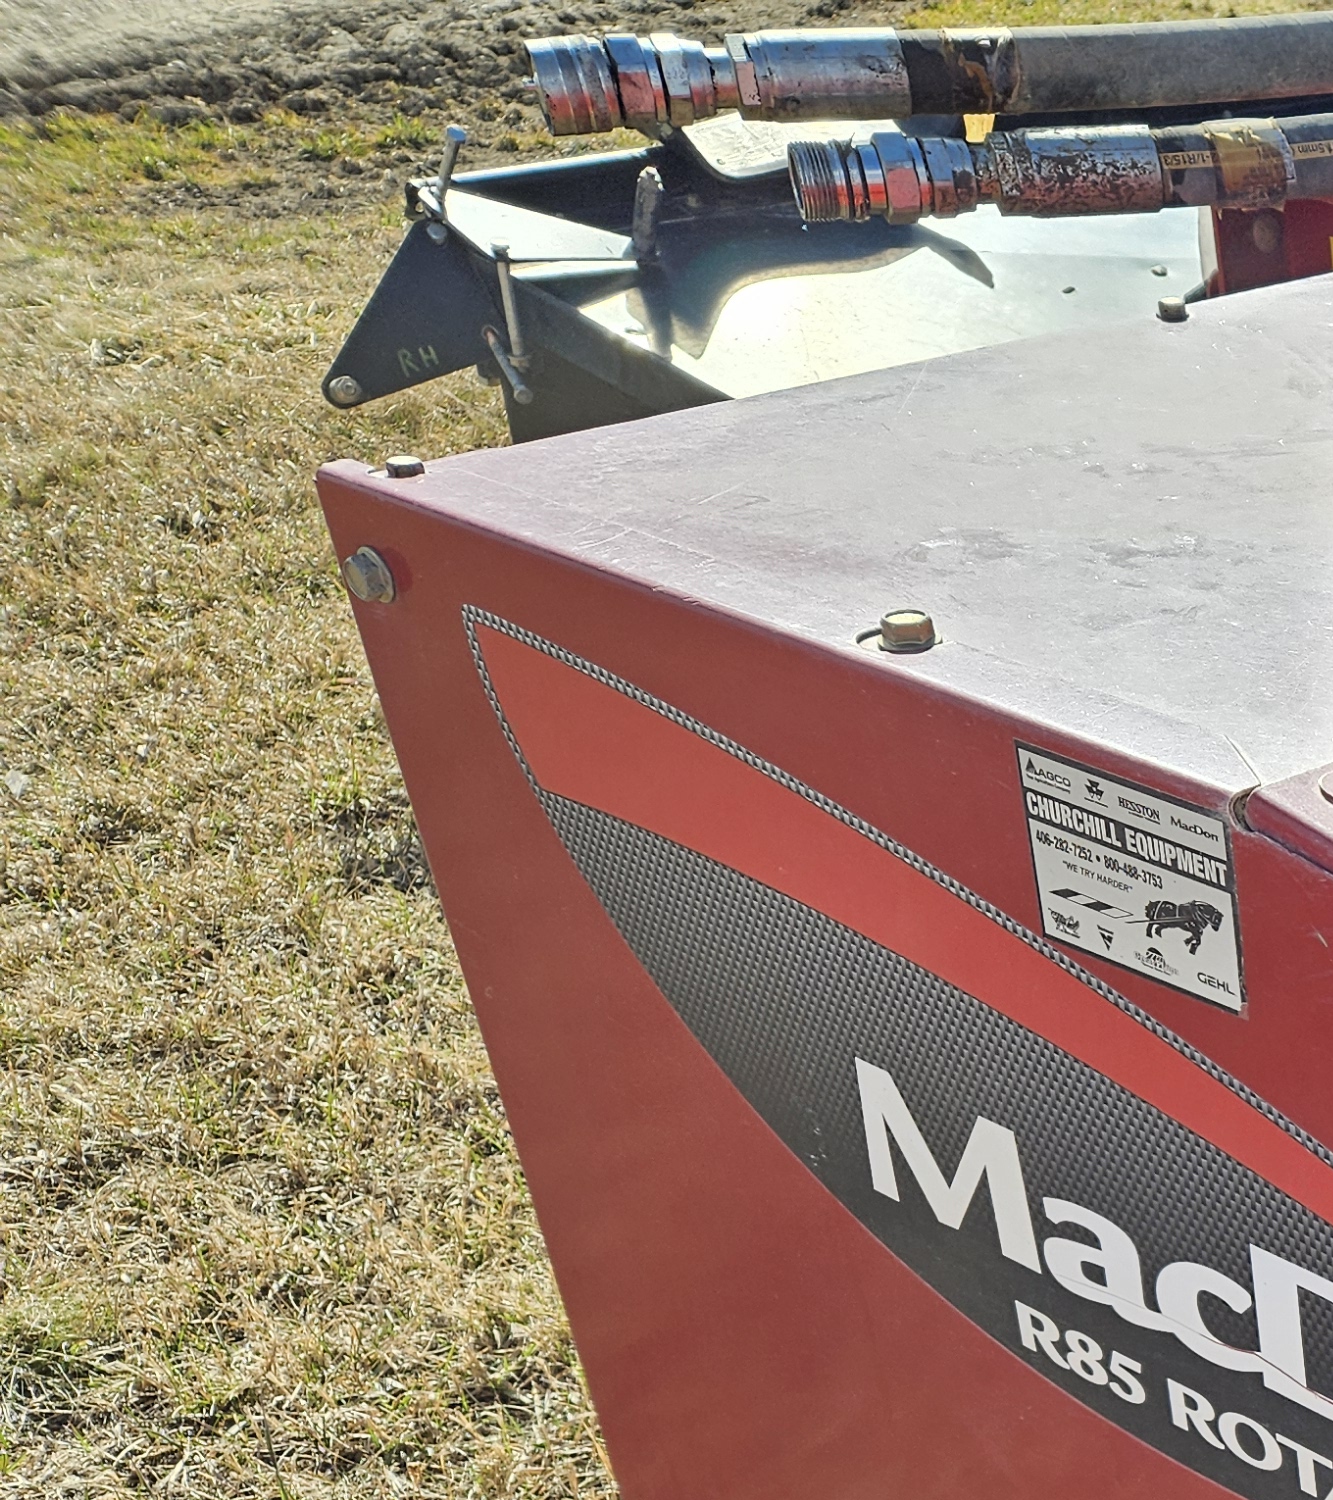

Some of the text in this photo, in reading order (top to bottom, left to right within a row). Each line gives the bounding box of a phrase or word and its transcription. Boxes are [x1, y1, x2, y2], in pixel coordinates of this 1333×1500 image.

[397, 345, 440, 378] RH
[1117, 796, 1161, 821] HESSTON
[1026, 791, 1228, 887] CHURCHILL EQUIPMENT
[1170, 815, 1219, 842] MacDon
[1079, 866, 1096, 880] TRY
[1197, 972, 1238, 997] GEHL
[1014, 1299, 1146, 1405] R85
